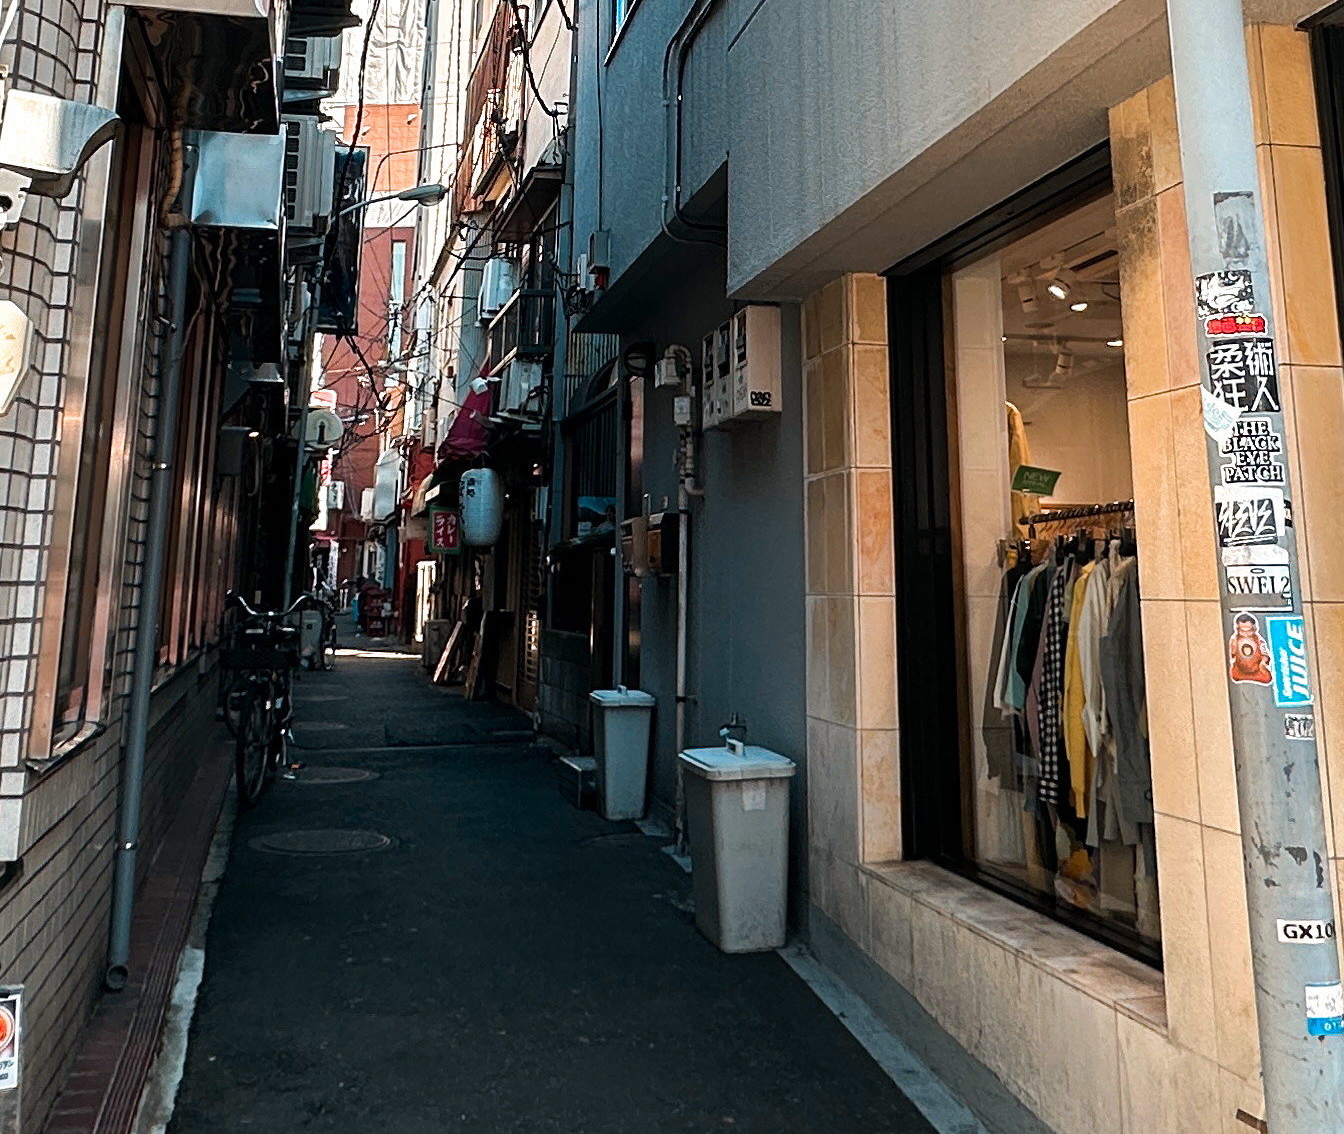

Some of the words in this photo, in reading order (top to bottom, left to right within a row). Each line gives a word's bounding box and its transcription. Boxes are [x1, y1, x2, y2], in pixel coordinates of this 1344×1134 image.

[1232, 420, 1269, 436] THE
[1222, 435, 1280, 453] BLACK
[1235, 451, 1271, 466] EYE
[1224, 465, 1284, 483] PATCH
[436, 514, 446, 547] ライス
[1286, 620, 1310, 699] JUICE
